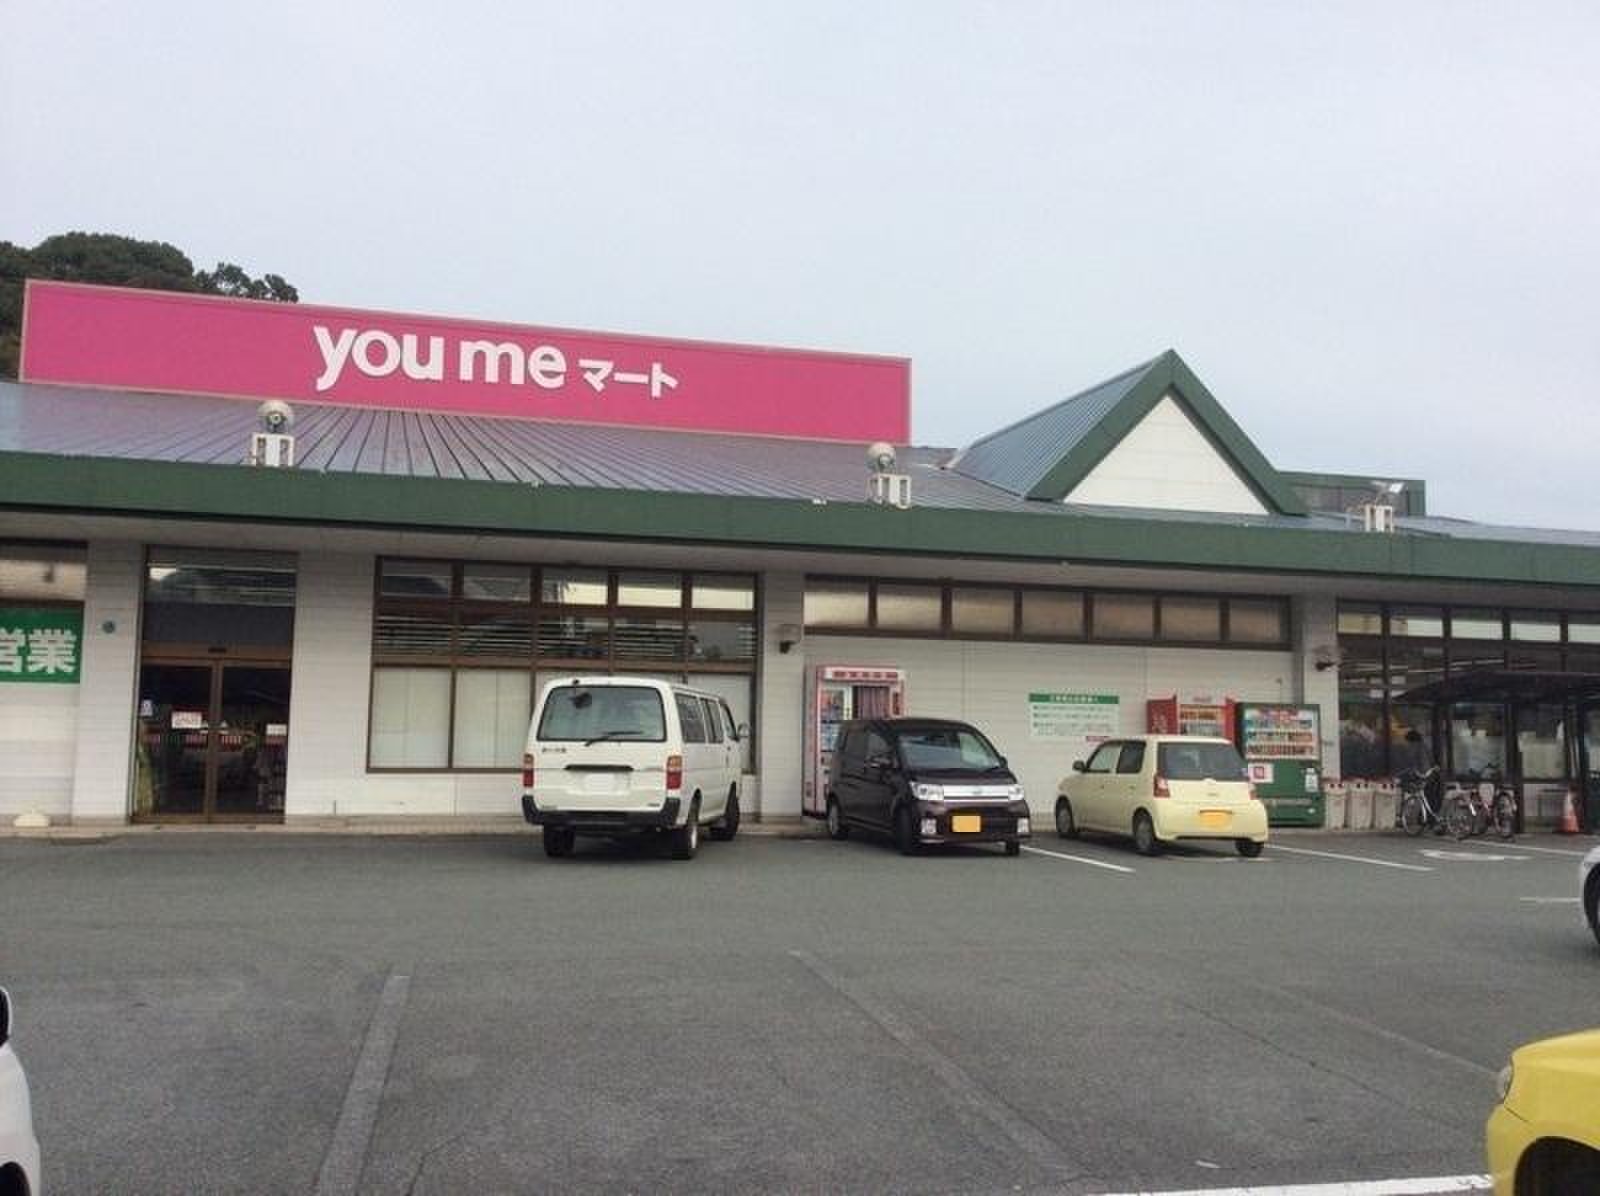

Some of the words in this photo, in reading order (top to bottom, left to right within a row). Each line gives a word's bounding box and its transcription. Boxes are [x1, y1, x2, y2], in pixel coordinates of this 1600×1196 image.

[313, 325, 444, 391] you
[459, 340, 567, 389] me
[577, 358, 679, 398] マート
